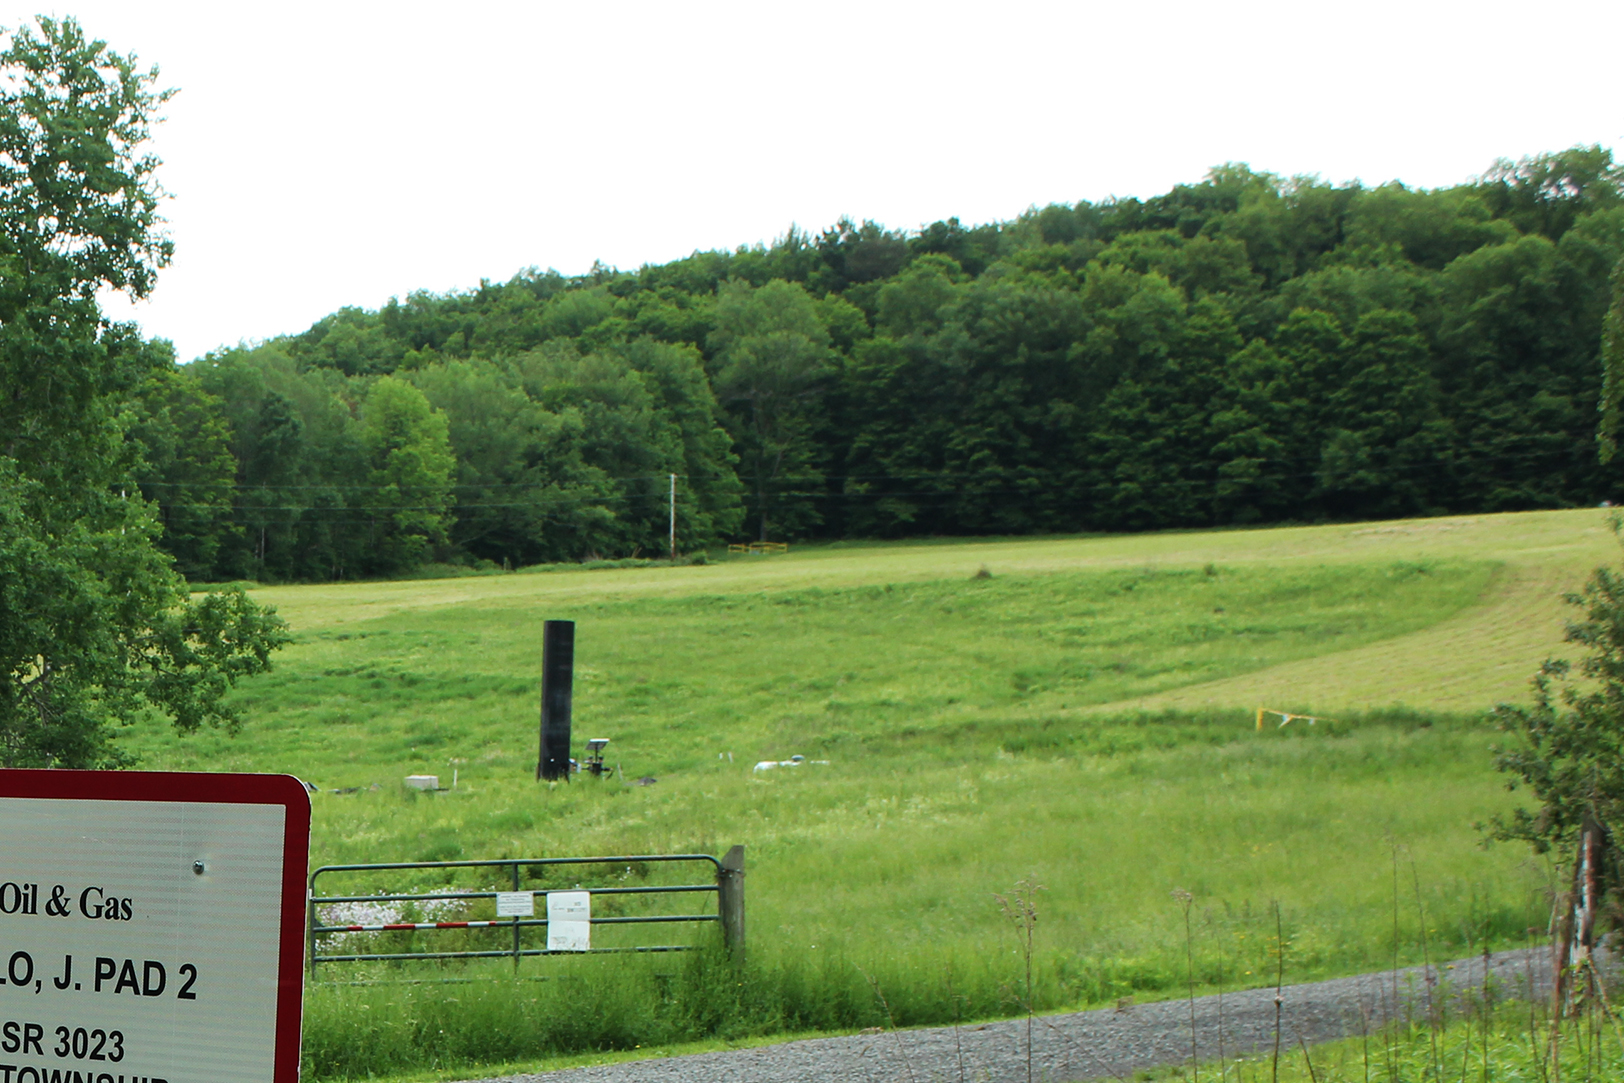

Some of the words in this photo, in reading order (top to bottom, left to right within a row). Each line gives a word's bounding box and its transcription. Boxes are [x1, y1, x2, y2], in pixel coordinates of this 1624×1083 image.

[44, 884, 72, 918] &
[79, 886, 133, 922] Gas
[53, 954, 82, 991] J.
[94, 956, 167, 997] PAD
[177, 963, 198, 1001] 2
[1, 1021, 45, 1056] SR
[53, 1025, 125, 1063] 3023
